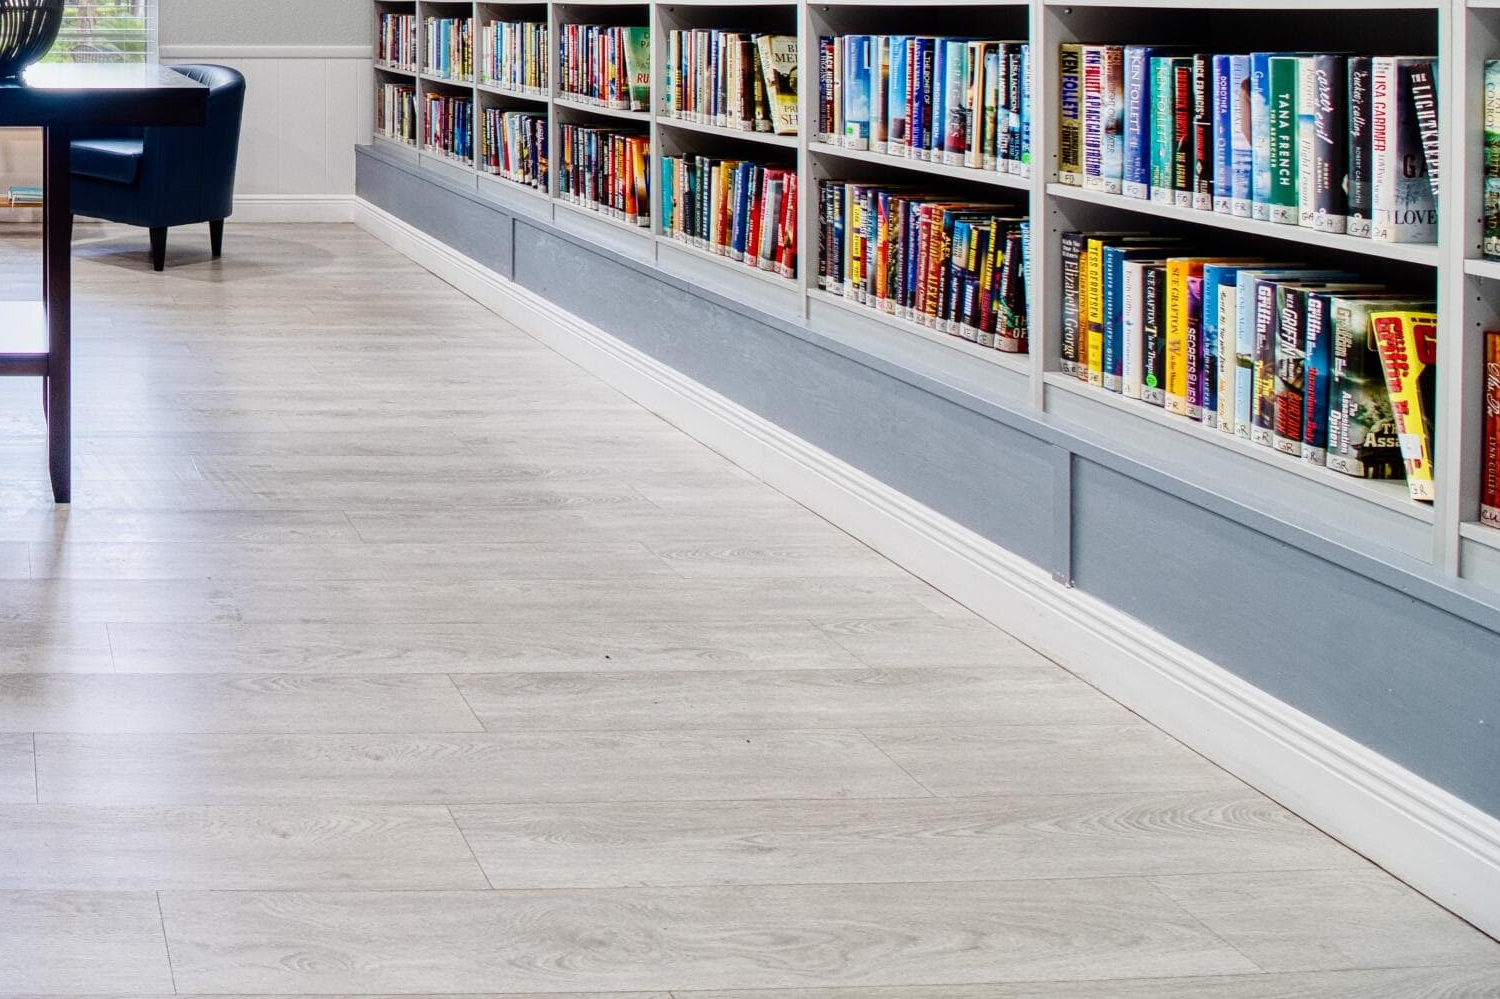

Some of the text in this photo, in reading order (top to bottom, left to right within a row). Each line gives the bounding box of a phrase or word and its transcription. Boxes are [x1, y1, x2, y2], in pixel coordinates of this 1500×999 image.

[1062, 51, 1079, 120] KEN FOLLETT
[1086, 50, 1100, 96] KEN FOLLETT
[1130, 56, 1142, 135] KEN FOLLETT
[1220, 75, 1229, 114] DOROTHEA
[1411, 73, 1427, 83] THE
[1373, 75, 1386, 152] LISA GARDNER
[1486, 82, 1496, 130] CONROY
[1278, 93, 1291, 186] TANA FRENCH
[1274, 209, 1288, 220] FR
[1350, 221, 1370, 236] GA
[1395, 209, 1437, 225] LOVE
[1089, 246, 1098, 319] TESS GERRITSEN
[1147, 270, 1156, 329] SUE GRAFTON
[1170, 267, 1180, 335] SUE GRAFTON
[1064, 260, 1079, 360] Elizabeth George
[1188, 327, 1197, 403] SECRETS LIES
[1263, 378, 1274, 397] The
[1329, 409, 1342, 448] Option
[1340, 390, 1352, 454] Assassination
[1349, 397, 1359, 417] The
[1278, 441, 1294, 453] GR
[1331, 459, 1348, 472] GR
[1488, 437, 1497, 495] LYNN CULLEN
[1411, 484, 1428, 496] GR
